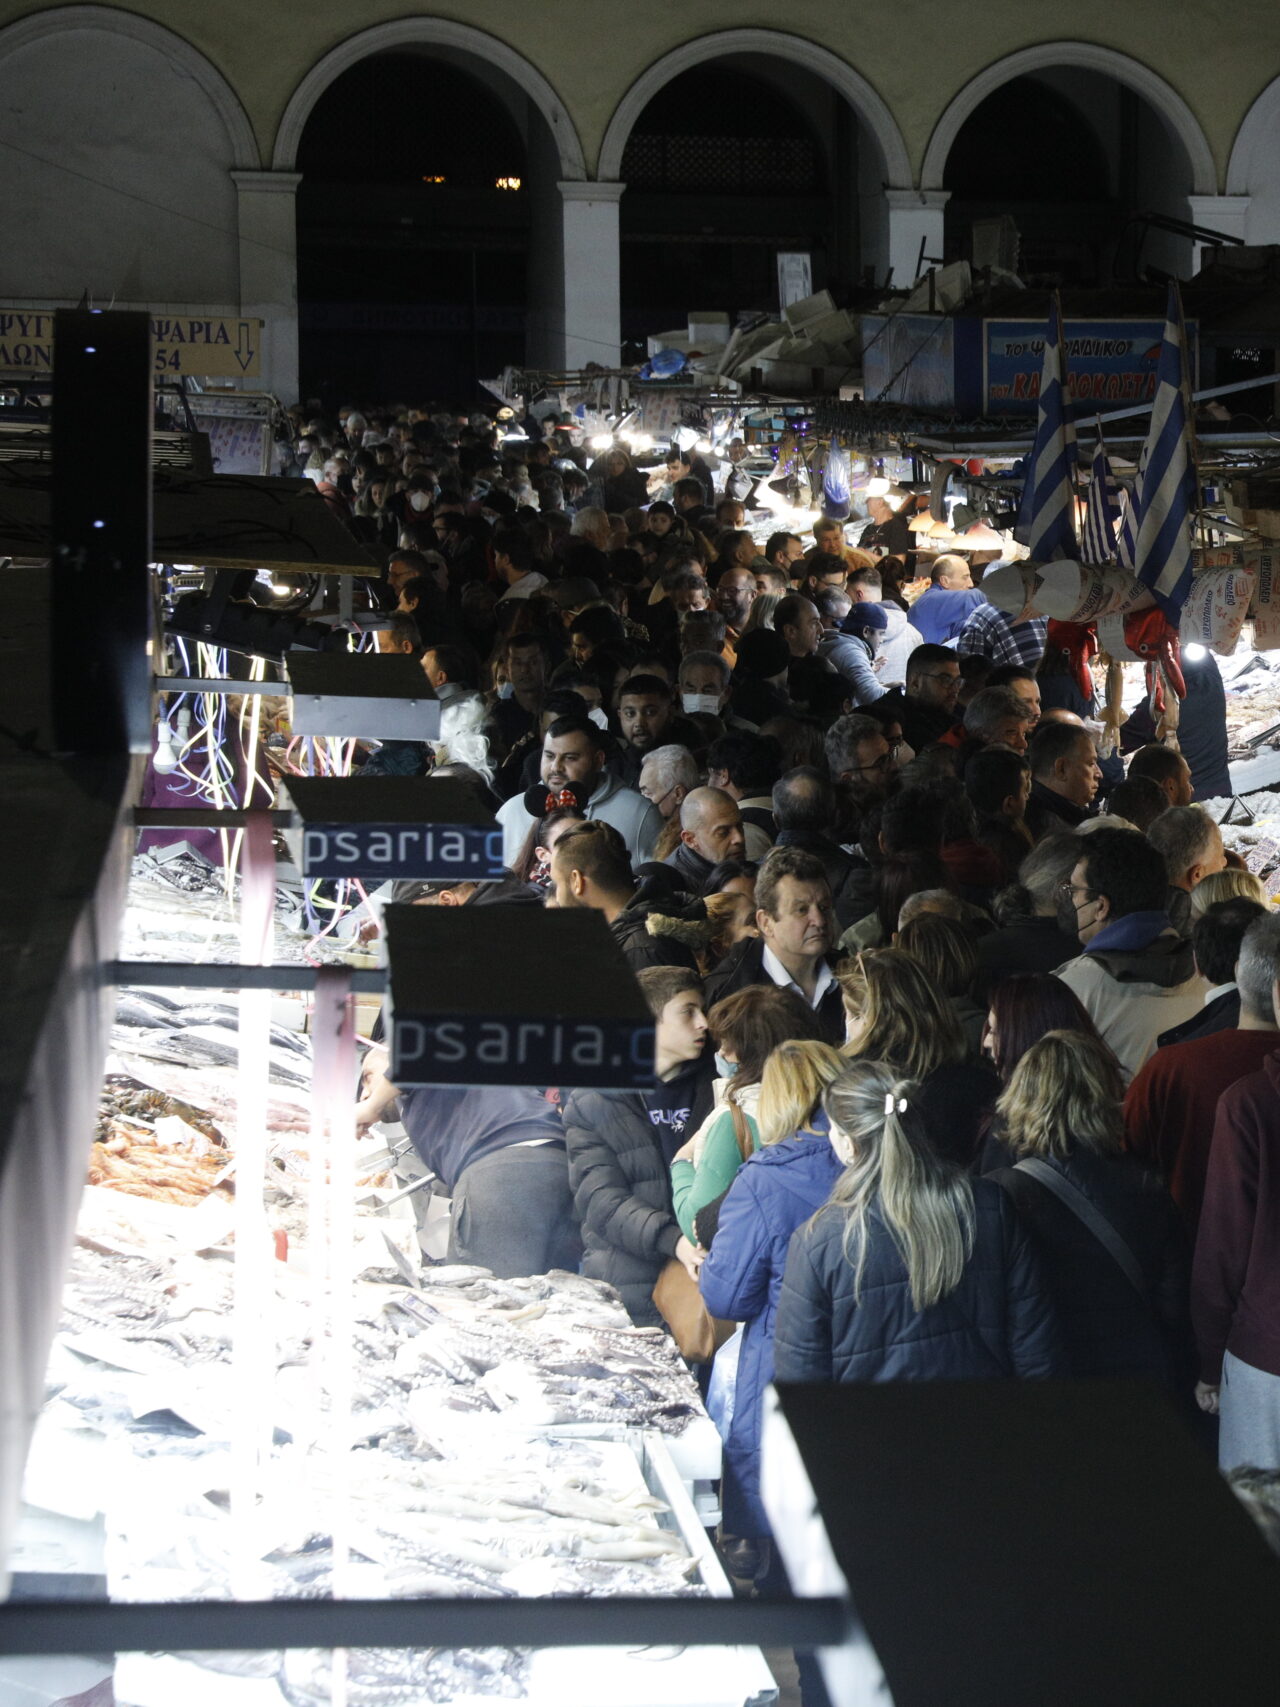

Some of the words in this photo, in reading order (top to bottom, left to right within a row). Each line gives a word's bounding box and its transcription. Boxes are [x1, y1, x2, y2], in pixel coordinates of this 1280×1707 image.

[149, 319, 231, 344] ΨΑΡΙΑ
[155, 349, 181, 370] 54
[1261, 555, 1272, 603] ΙΧΘΥΟΠΩΛΕΙΟ
